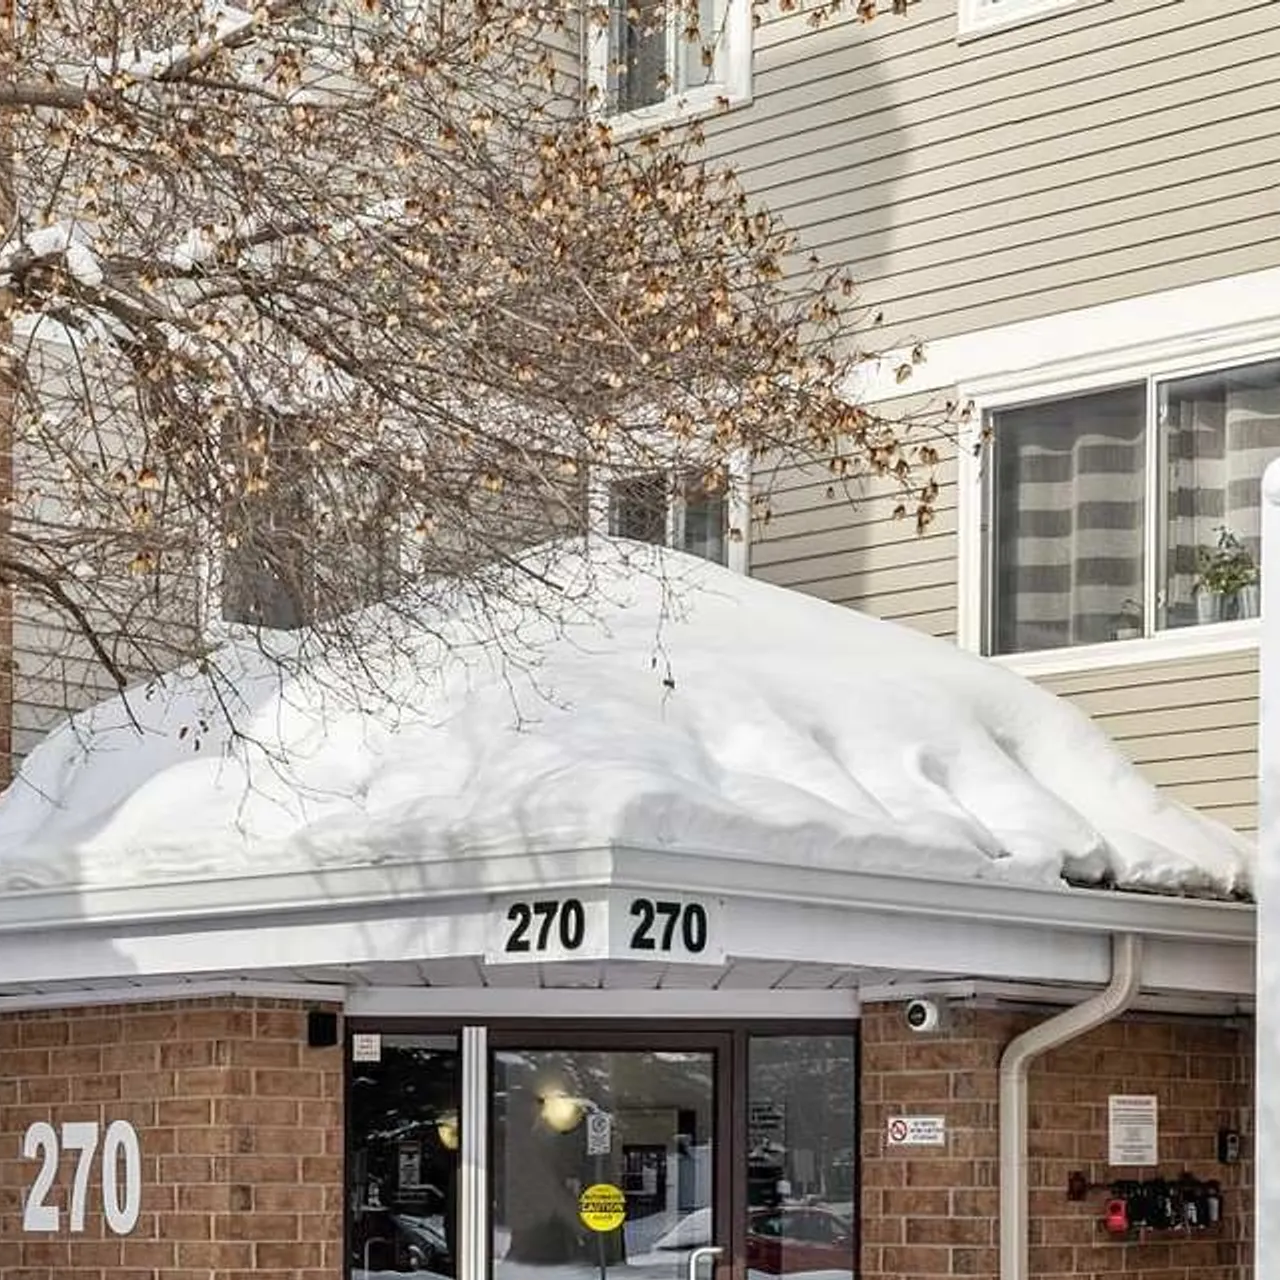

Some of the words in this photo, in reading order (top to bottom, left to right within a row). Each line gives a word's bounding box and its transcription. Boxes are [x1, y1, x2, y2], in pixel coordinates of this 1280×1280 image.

[505, 898, 586, 953] 270
[630, 897, 708, 954] 270
[22, 1119, 142, 1235] 270
